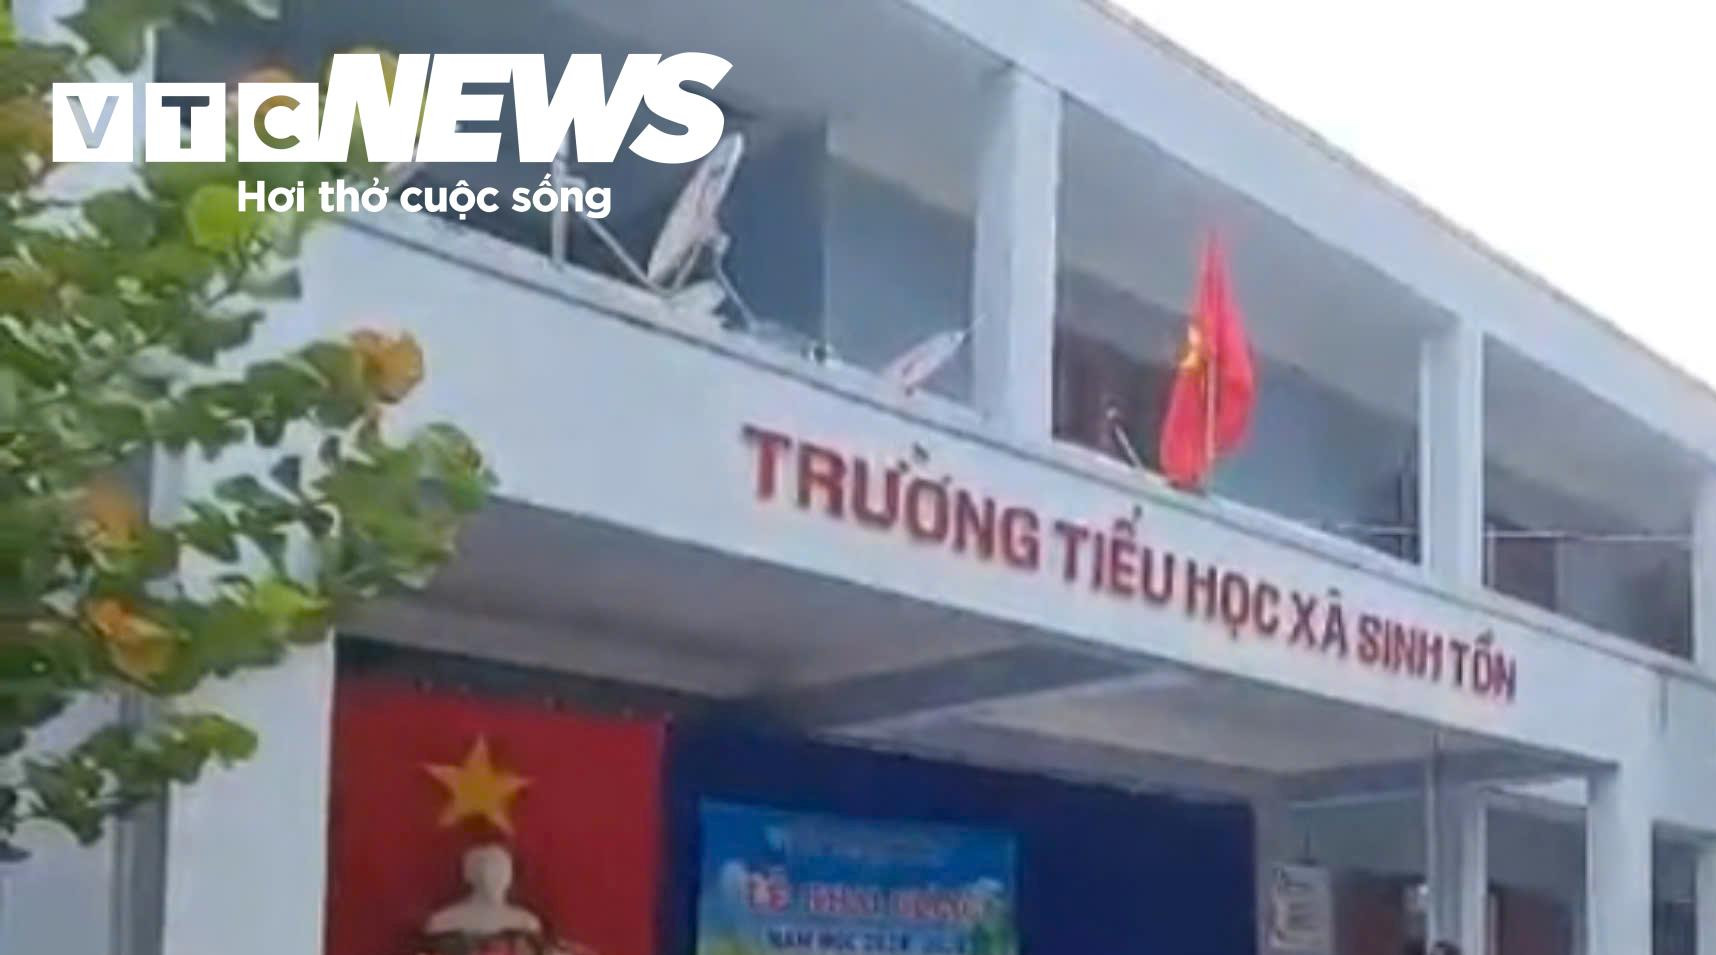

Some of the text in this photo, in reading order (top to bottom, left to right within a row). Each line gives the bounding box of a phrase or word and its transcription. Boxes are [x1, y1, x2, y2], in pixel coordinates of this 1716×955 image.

[741, 423, 1040, 570] TRƯỜNG
[1055, 505, 1175, 604] TIỂU
[1185, 558, 1280, 641] HỌC
[1288, 586, 1348, 659] XÃ
[1358, 612, 1443, 682] SINH
